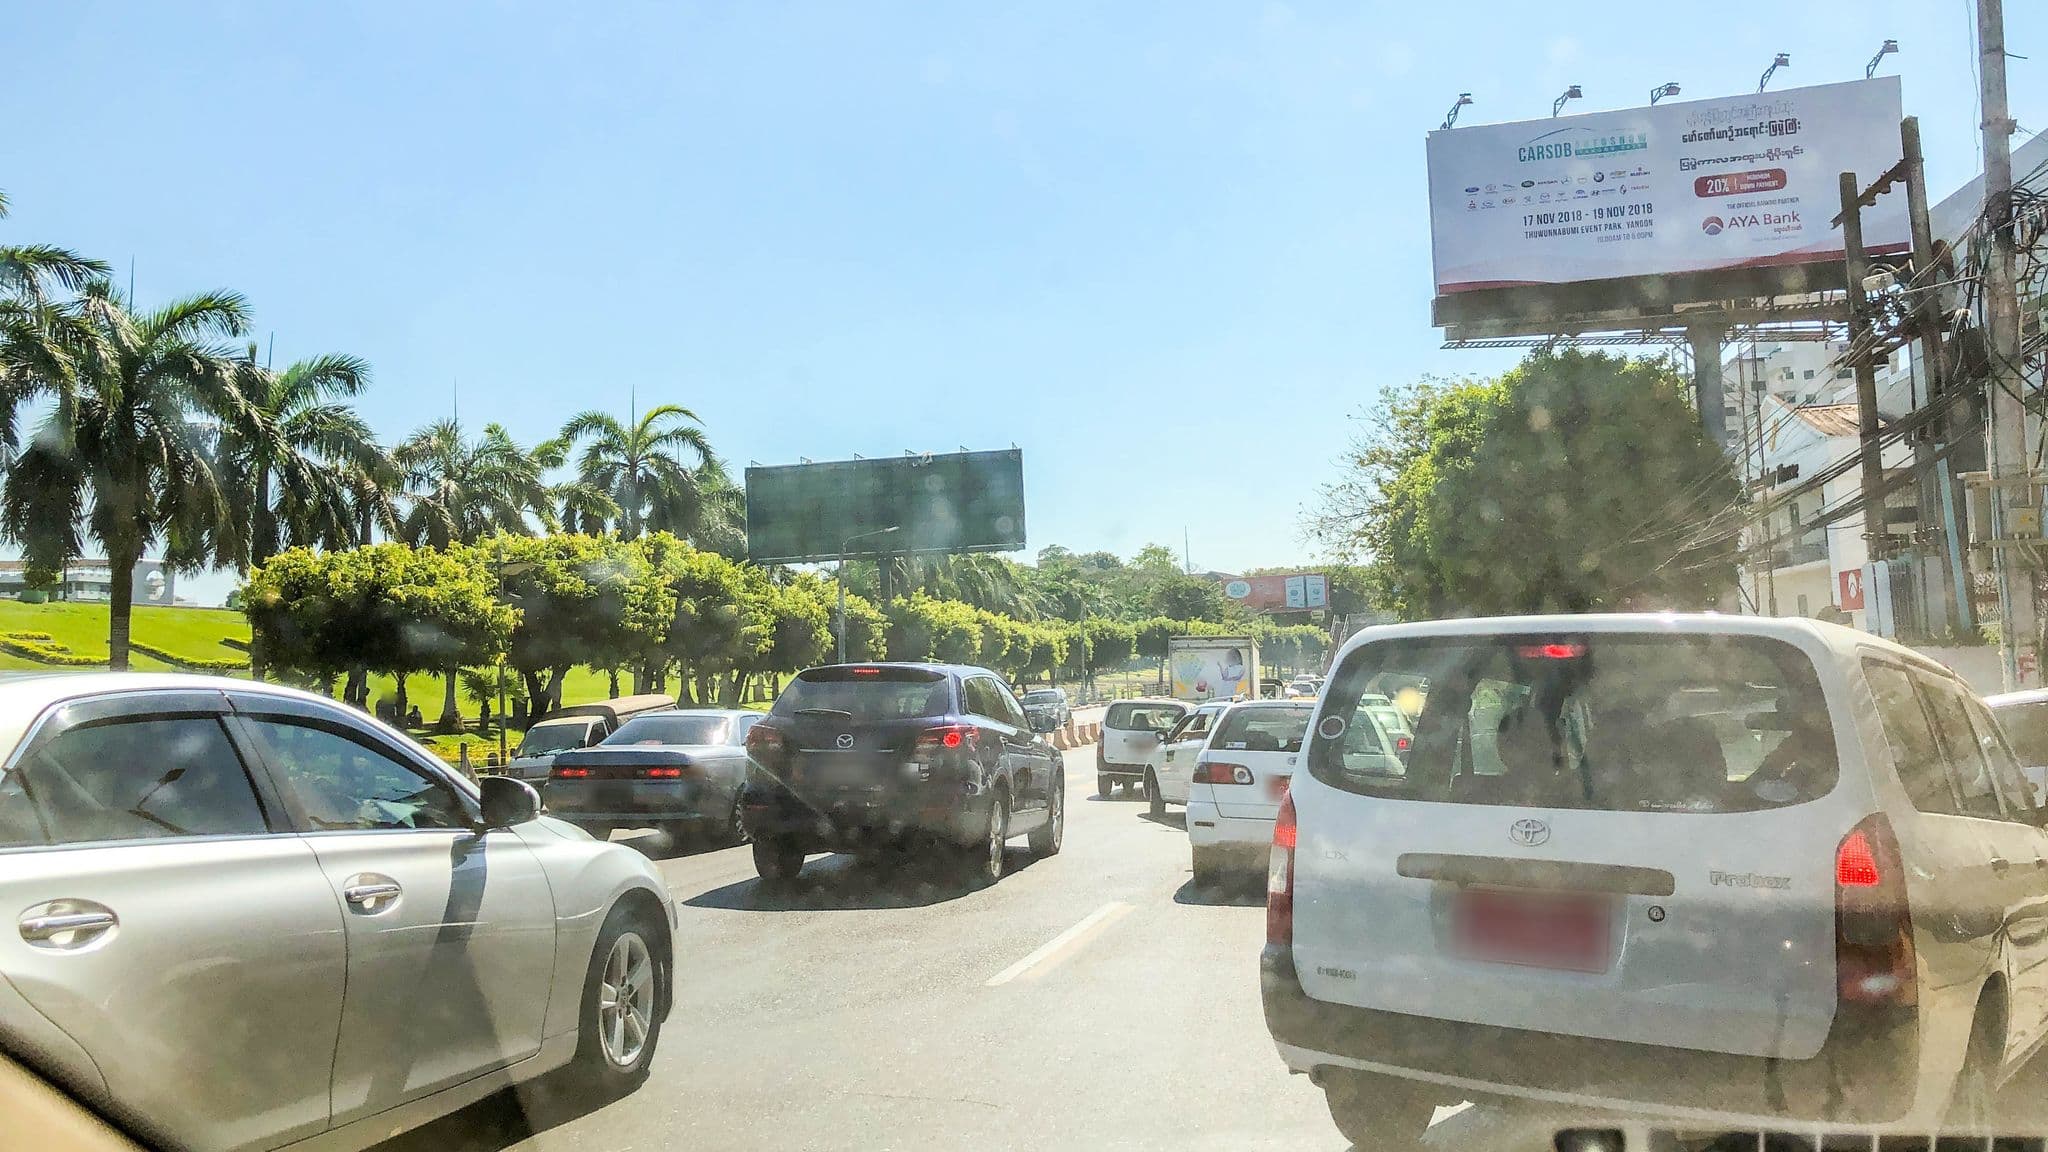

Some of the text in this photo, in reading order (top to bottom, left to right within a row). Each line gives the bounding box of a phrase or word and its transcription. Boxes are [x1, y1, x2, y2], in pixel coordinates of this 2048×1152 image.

[1518, 142, 1572, 162] CARSDB
[1707, 178, 1730, 193] 20%
[1523, 215, 1534, 226] 17
[1536, 213, 1555, 225] NOV
[1558, 210, 1582, 223] 2018
[1593, 208, 1604, 219] 19
[1606, 205, 1625, 218] NOV
[1628, 203, 1653, 215] 2018
[1728, 211, 1801, 229] AYA Bank
[1581, 224, 1602, 234] EVENT
[1626, 219, 1653, 229] YANGON
